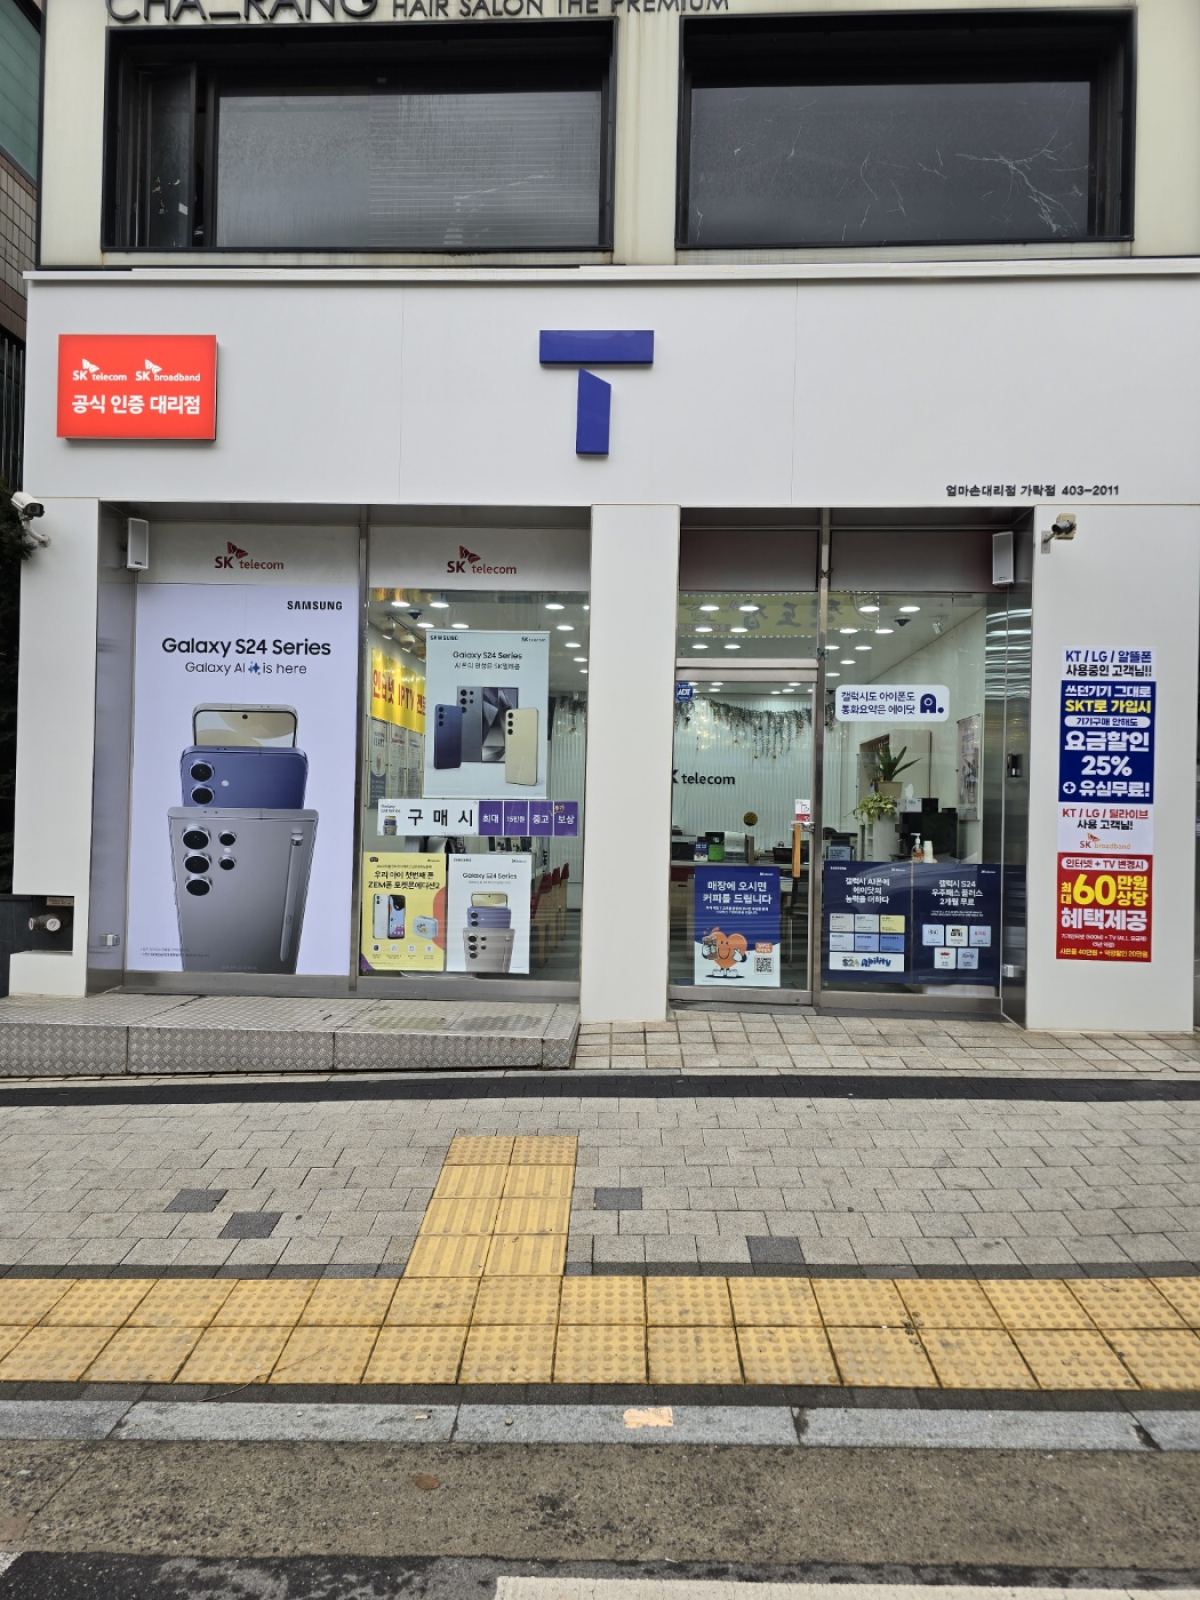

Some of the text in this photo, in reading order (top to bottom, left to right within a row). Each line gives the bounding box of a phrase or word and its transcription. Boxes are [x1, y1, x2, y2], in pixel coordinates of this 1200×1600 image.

[393, 0, 448, 17] HAIR
[459, 0, 542, 16] SALON
[611, 0, 729, 12] PREMIUM
[72, 370, 127, 382] SK telecom
[135, 371, 201, 382] SK broadband
[72, 394, 200, 415] 공식 인증 대리점
[946, 484, 1119, 497] 엄마손대리점 가락점 403-2011
[214, 556, 284, 570] SK telecom
[447, 561, 517, 575] SK telecom
[287, 600, 343, 610] SAMSUNG
[162, 637, 331, 658] Galaxy S24 Series
[453, 651, 523, 660] Galaxy S24 Series
[1066, 650, 1081, 662] KT
[1092, 650, 1107, 662] LG
[1118, 650, 1152, 663] 알뜰폰
[185, 661, 307, 676] Galaxy AI is here
[1066, 664, 1152, 677] 사용중인 고객님!!
[841, 691, 916, 702] 갤럭시도 아이폰도
[1065, 685, 1152, 697] 쓰던기기 그대로
[841, 704, 916, 715] 통화요약은 에이닷
[1065, 699, 1151, 713] SKT로 가입시
[1076, 717, 1138, 727] 기기구매 안해도
[1064, 730, 1149, 752] 요금할인
[1081, 755, 1133, 776] 25%
[681, 772, 735, 785] telecom
[1079, 780, 1150, 798] 유심무료!
[482, 814, 499, 824] 최대
[532, 814, 549, 825] 중고
[558, 814, 575, 825] 보상
[1062, 808, 1077, 818] KT
[1086, 808, 1100, 818] LG
[1109, 809, 1149, 819] 딜라이브
[1077, 819, 1133, 831] 사용 고객님!
[1094, 841, 1131, 850] broadband
[1066, 859, 1093, 868] 인터넷
[1103, 860, 1116, 869] TV
[1118, 860, 1144, 870] 변경시
[374, 871, 389, 879] 우리
[390, 871, 404, 879] 아이
[462, 872, 485, 880] Galaxy
[498, 872, 517, 880] Series
[707, 880, 767, 892] 매장에 오시면
[961, 880, 976, 888] S24
[1061, 873, 1148, 906] 최대 60 만원
[961, 888, 984, 897] 플러스
[703, 893, 772, 905] 커피를 드립니다
[867, 895, 890, 904] 더하다
[939, 897, 959, 906] 2개월
[1117, 891, 1149, 907] 상당
[1061, 908, 1148, 932] 혜택제공
